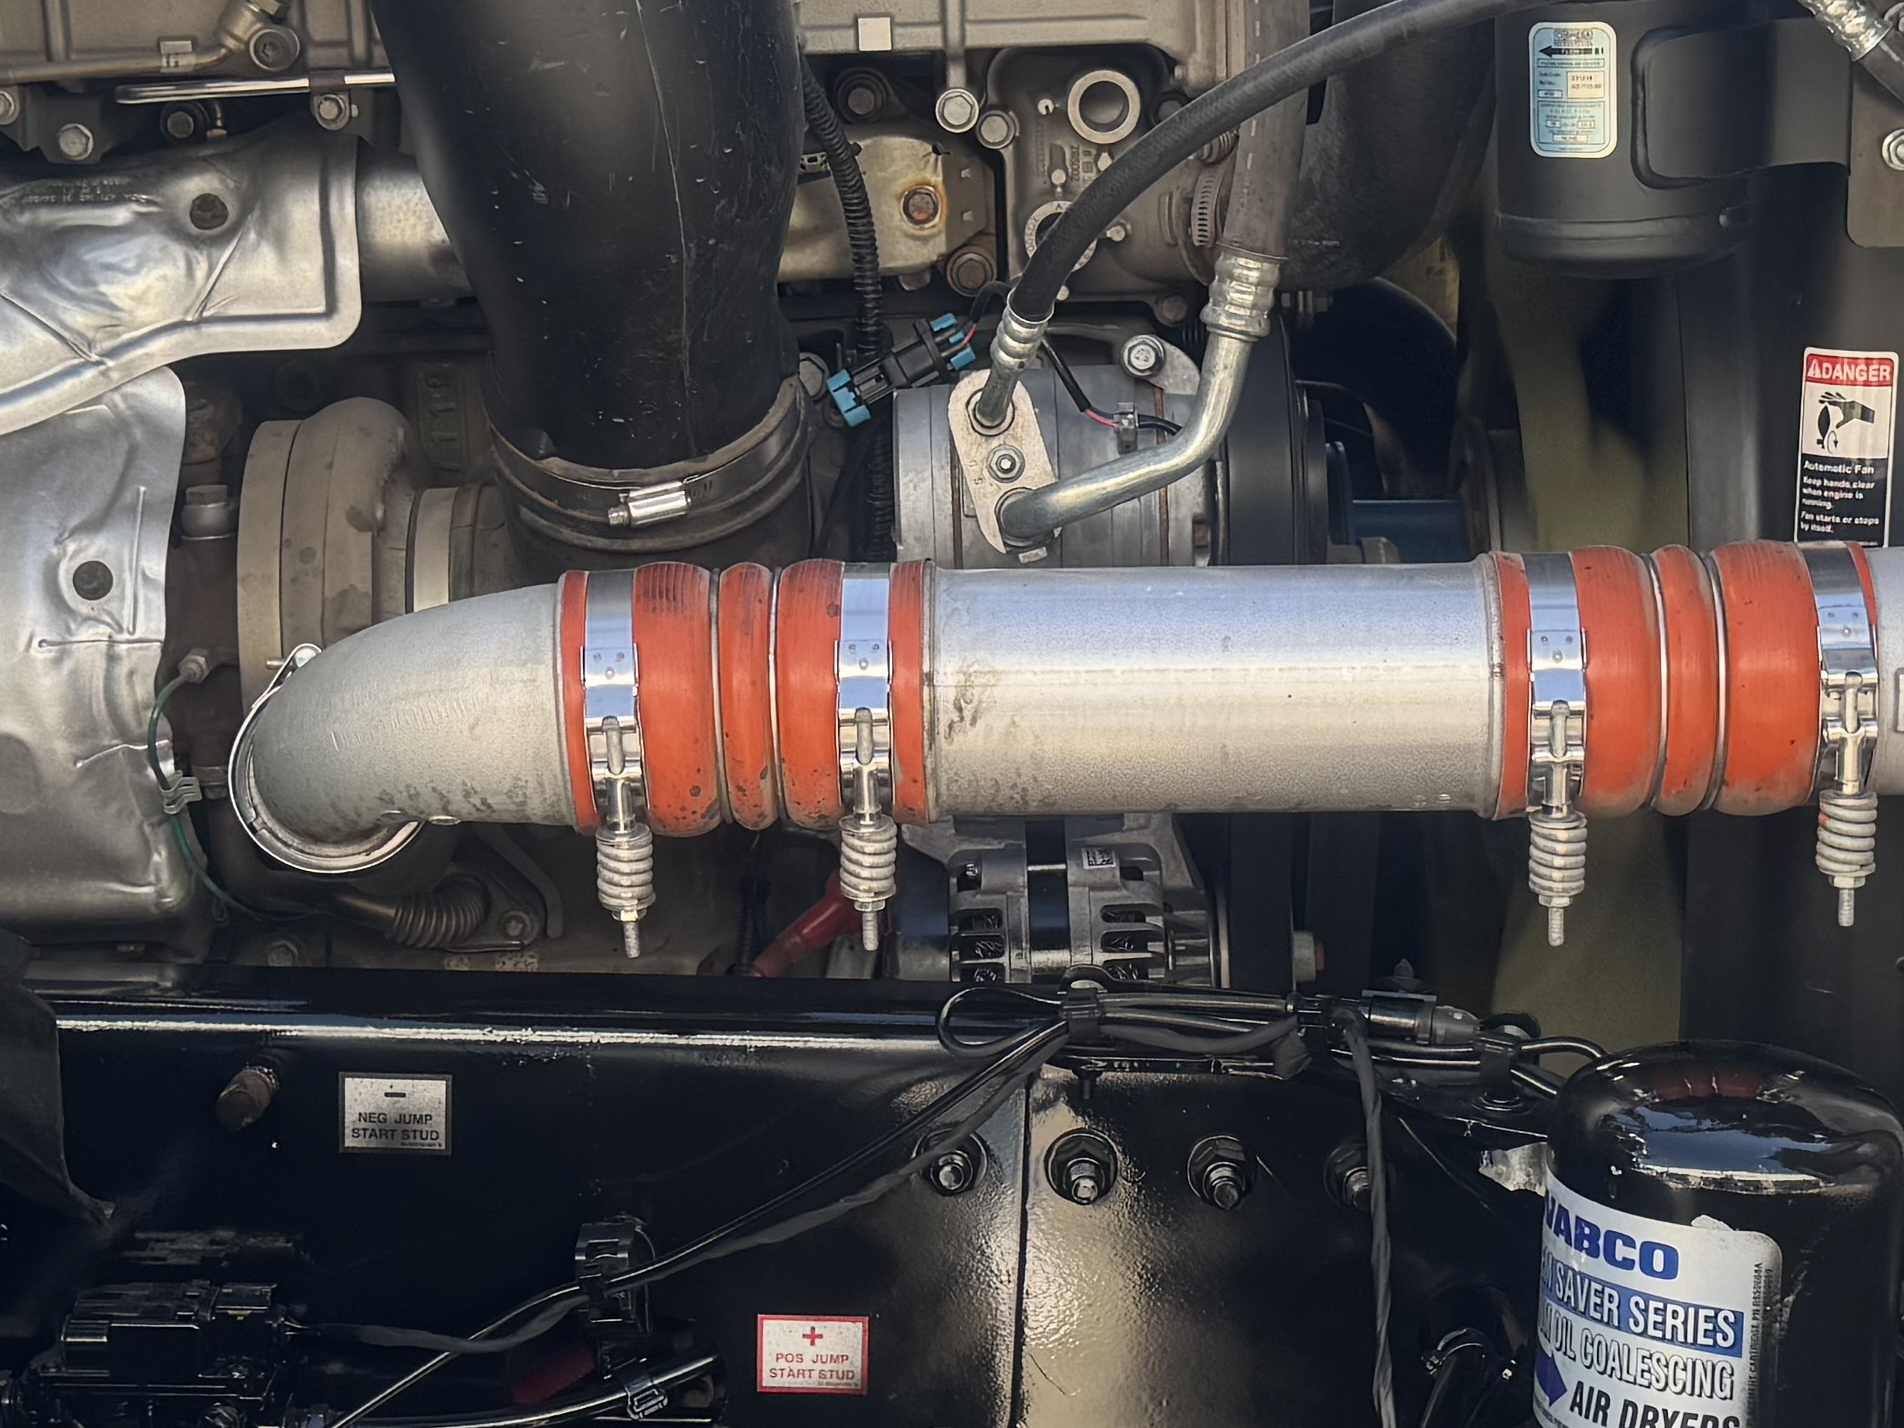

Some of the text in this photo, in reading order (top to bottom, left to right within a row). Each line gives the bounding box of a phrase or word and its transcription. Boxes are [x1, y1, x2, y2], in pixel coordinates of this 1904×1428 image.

[1821, 362, 1891, 382] DANGER
[1804, 460, 1875, 474] Automatic Fan
[1803, 476, 1822, 487] Keep
[1823, 490, 1854, 500] engine
[1855, 490, 1864, 500] is
[1816, 513, 1841, 524] starts
[1842, 516, 1852, 524] or
[1854, 517, 1880, 526] stops
[358, 1112, 433, 1125] NEG JUMP
[351, 1127, 440, 1141] START STUD
[1554, 1264, 1621, 1328] SAVER
[1629, 1295, 1737, 1349] SERIES
[775, 1352, 849, 1365] POS JUMP
[1554, 1312, 1577, 1363] OIL
[1580, 1327, 1735, 1401] COALESCING
[769, 1367, 856, 1381] START STUD
[1569, 1380, 1612, 1428] AIR
